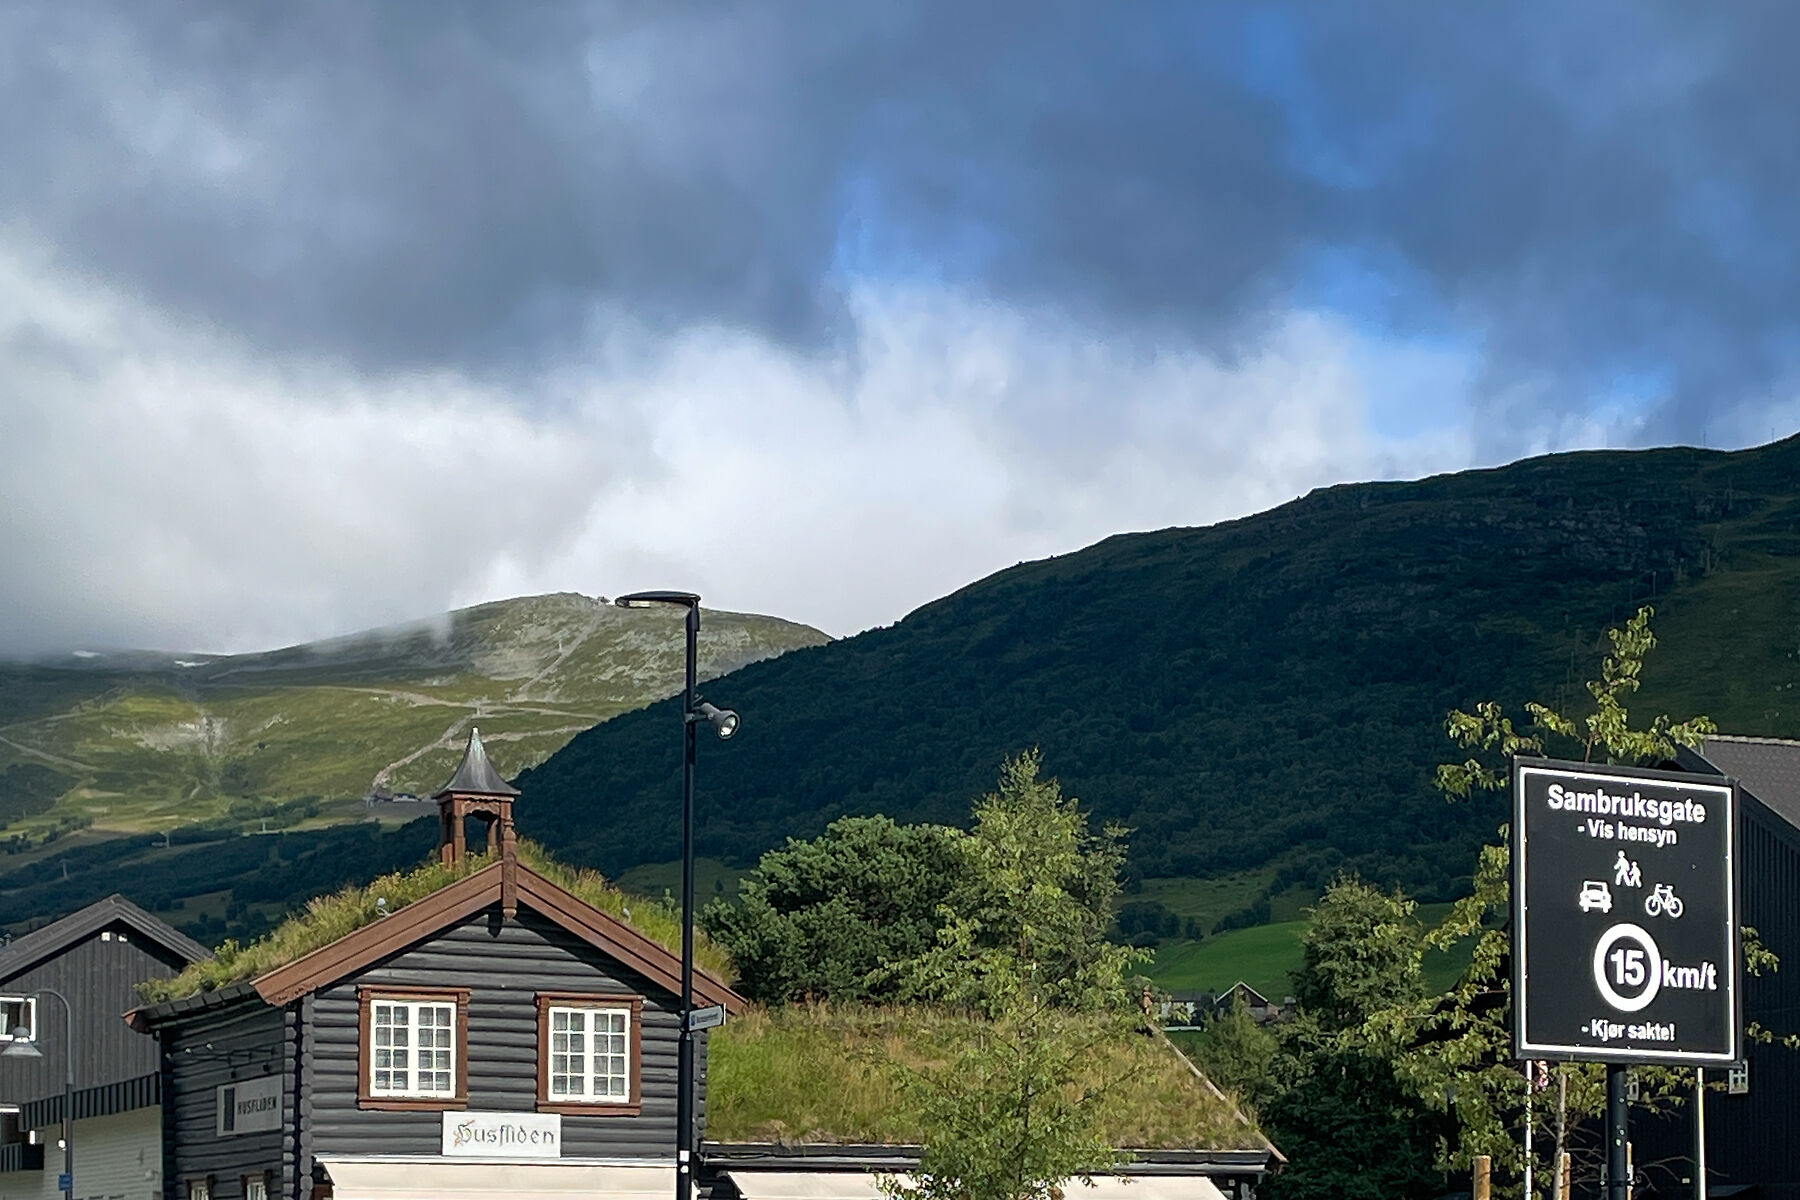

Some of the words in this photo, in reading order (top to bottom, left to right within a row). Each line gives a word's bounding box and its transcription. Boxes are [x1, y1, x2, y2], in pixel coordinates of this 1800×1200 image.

[1548, 784, 1706, 825] Sambruksgate
[1618, 820, 1677, 848] hensyn
[1610, 949, 1645, 986] 15
[1662, 960, 1717, 990] km/t
[1628, 1022, 1675, 1042] sakte!
[453, 1120, 555, 1148] Husfliden
